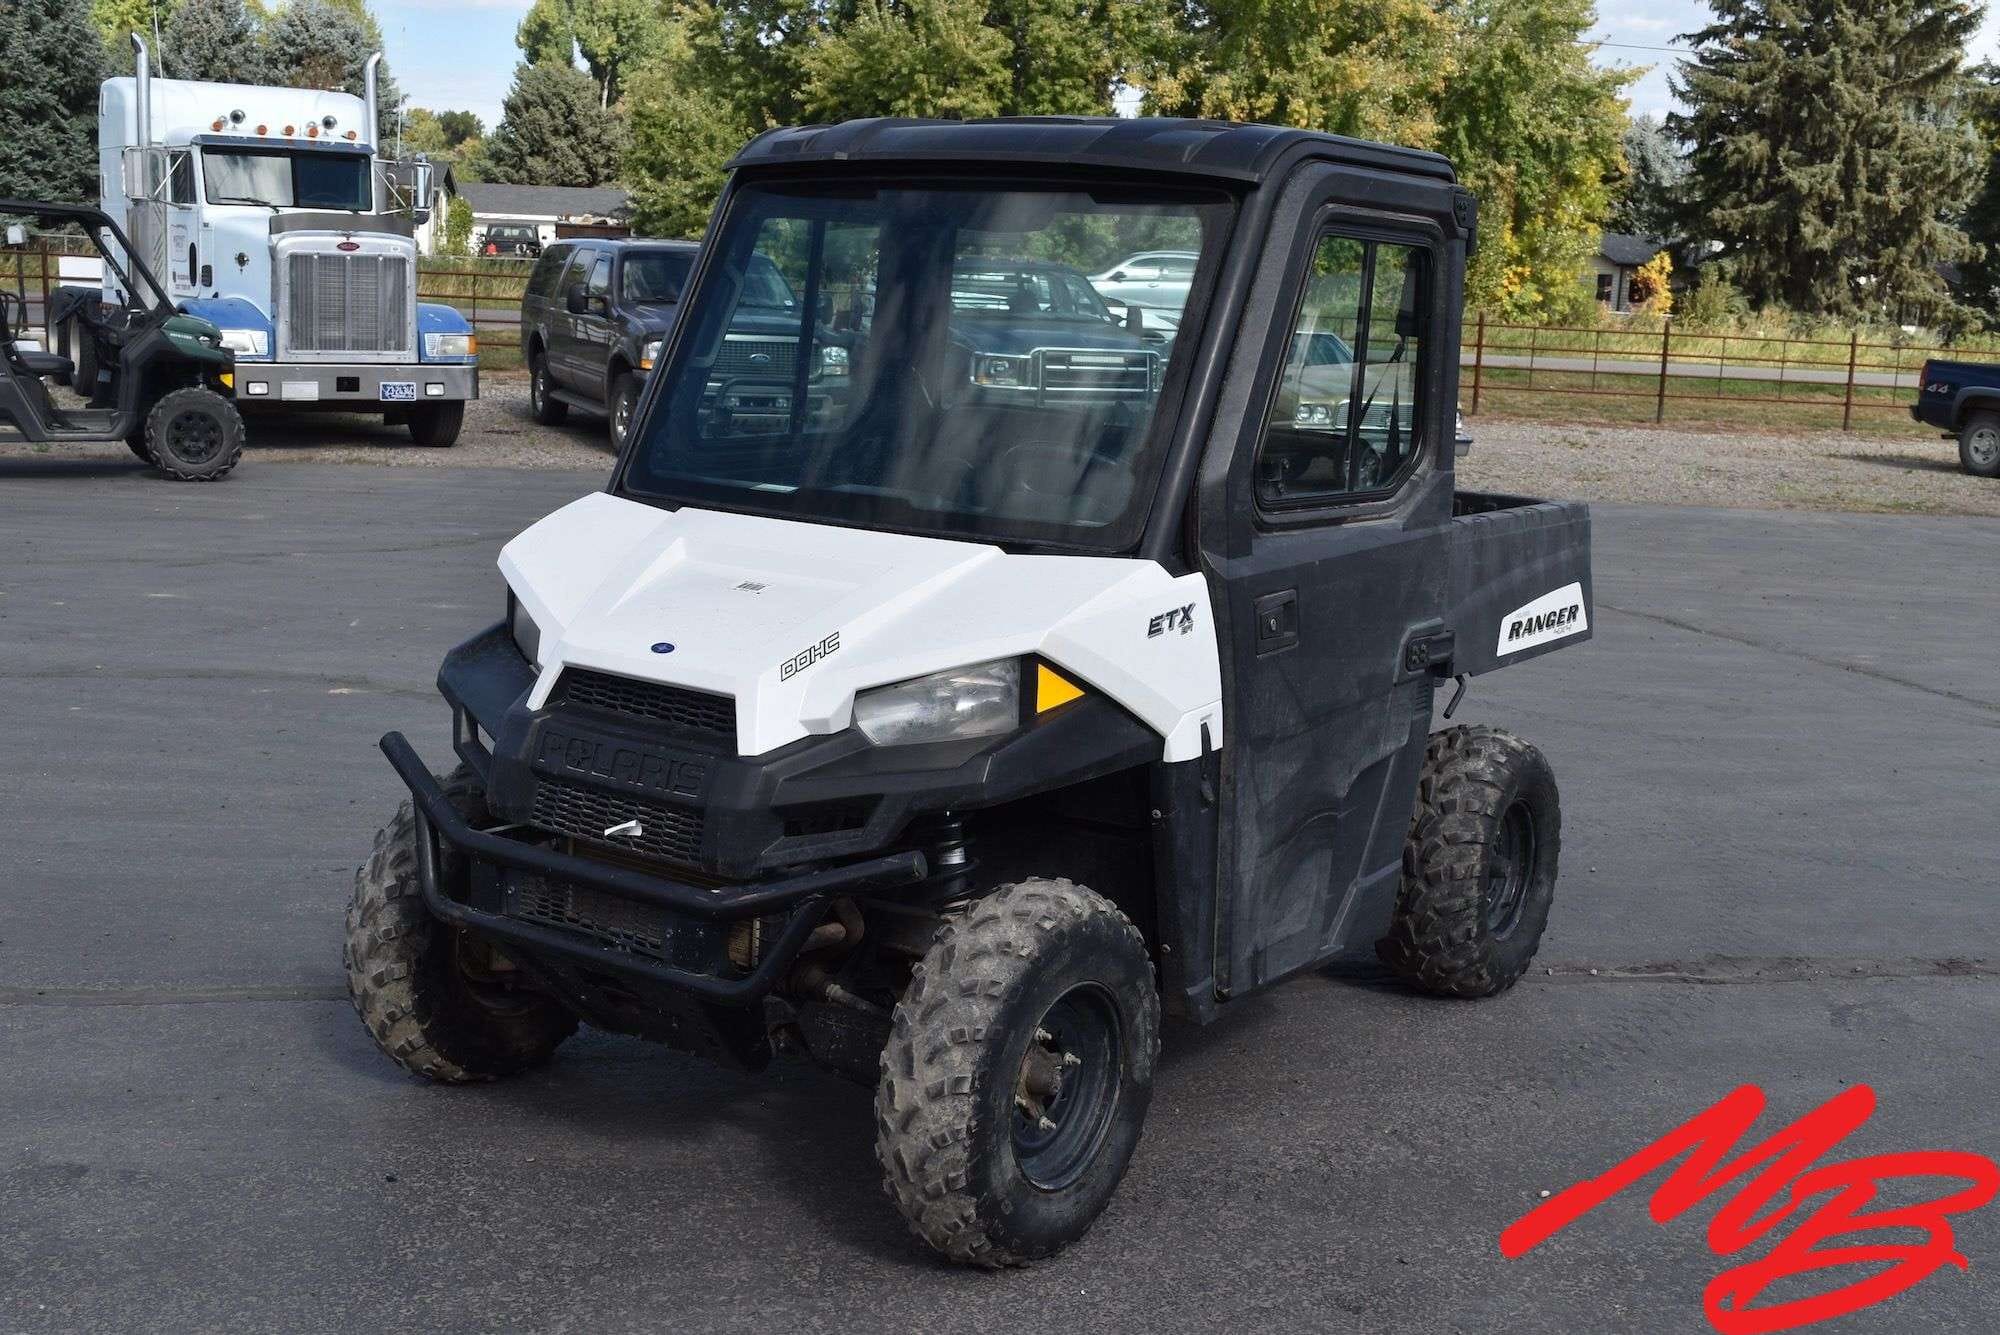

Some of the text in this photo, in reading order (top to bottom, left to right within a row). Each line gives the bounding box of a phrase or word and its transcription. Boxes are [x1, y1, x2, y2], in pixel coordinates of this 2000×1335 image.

[1147, 602, 1196, 639] ETX
[1508, 603, 1580, 642] RANGER
[780, 631, 840, 682] DOHC
[538, 730, 706, 798] POLARIS
